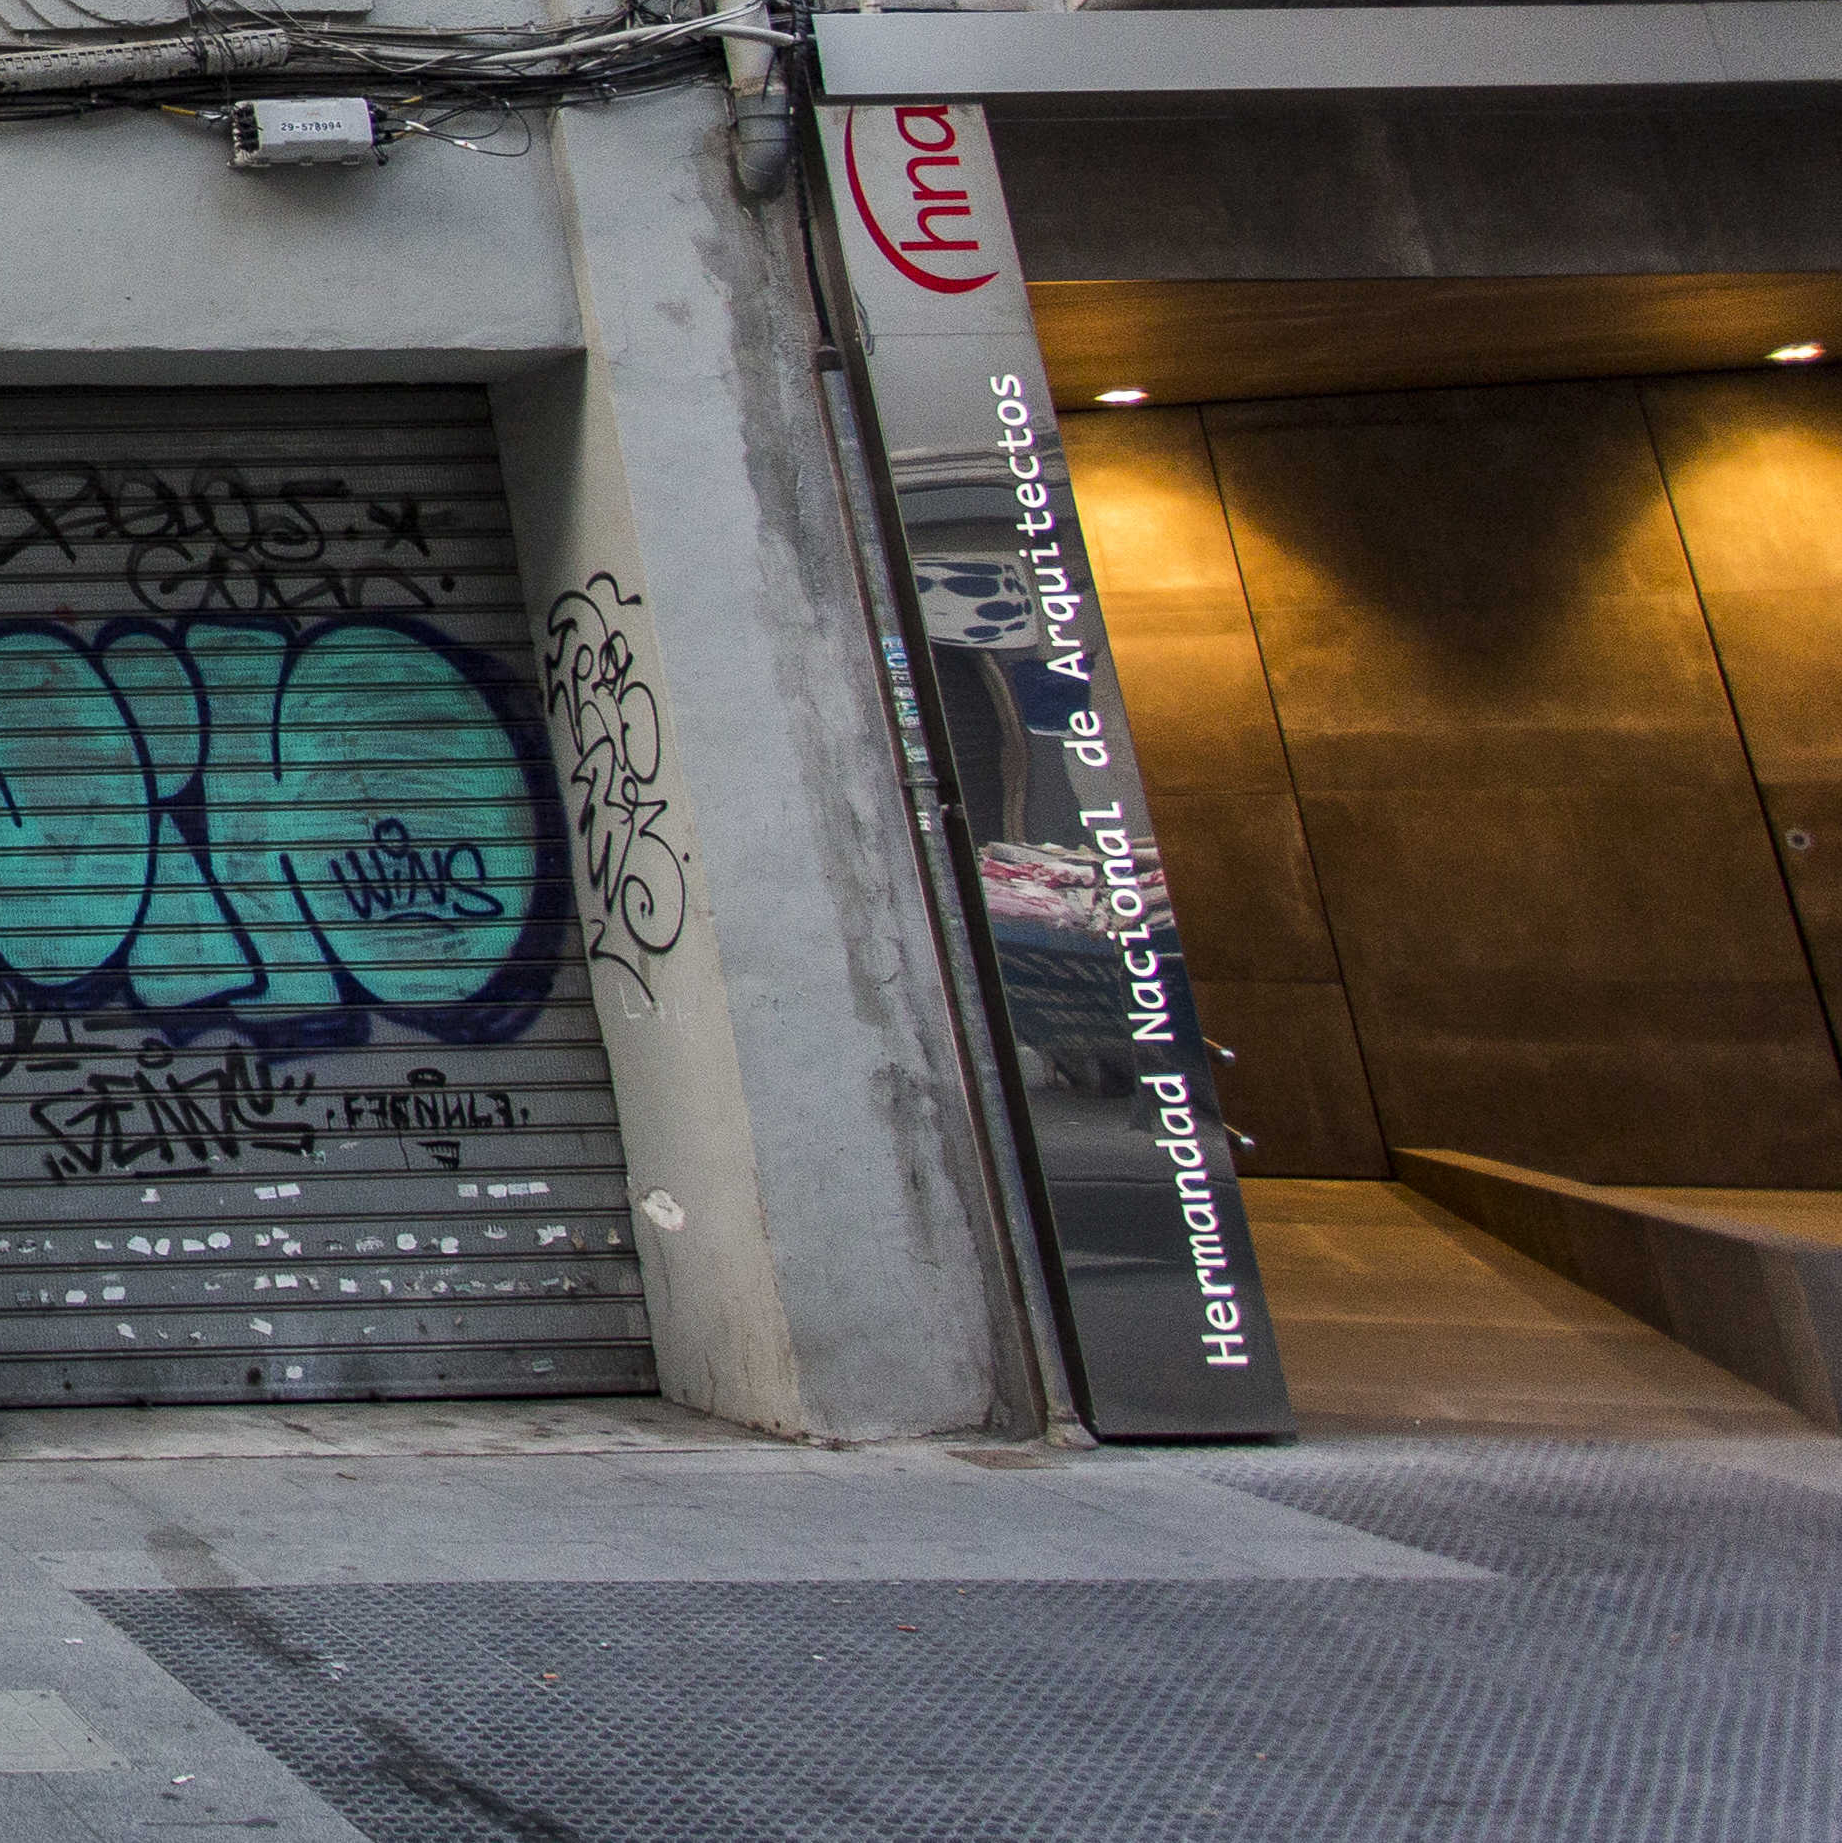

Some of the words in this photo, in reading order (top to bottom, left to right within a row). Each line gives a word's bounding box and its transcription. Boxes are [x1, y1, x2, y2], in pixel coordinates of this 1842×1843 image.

[894, 105, 980, 254] hna
[989, 371, 1094, 681] Arquitectos
[1063, 708, 1112, 768] de
[1079, 800, 1174, 1042] Nacional
[1140, 1072, 1249, 1367] Hermandad
